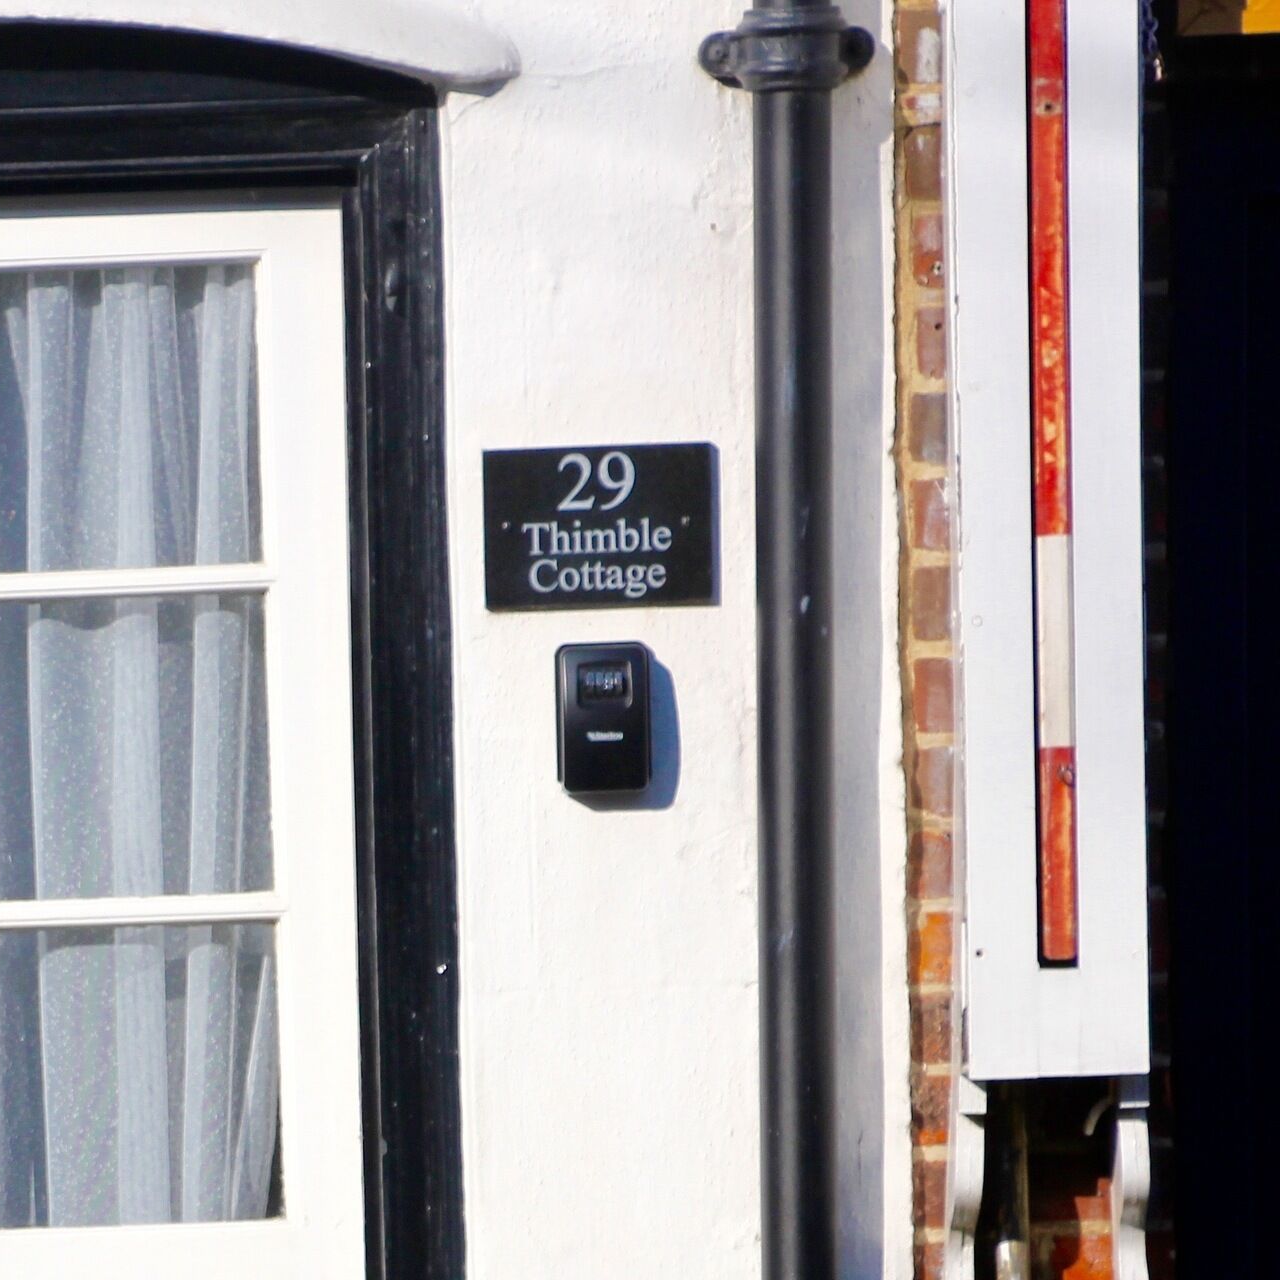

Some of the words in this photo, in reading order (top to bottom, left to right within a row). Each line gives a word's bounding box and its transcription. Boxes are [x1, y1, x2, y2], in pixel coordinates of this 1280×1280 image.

[556, 450, 637, 512] 29
[521, 517, 673, 556] Thimble
[528, 559, 667, 599] Cottage
